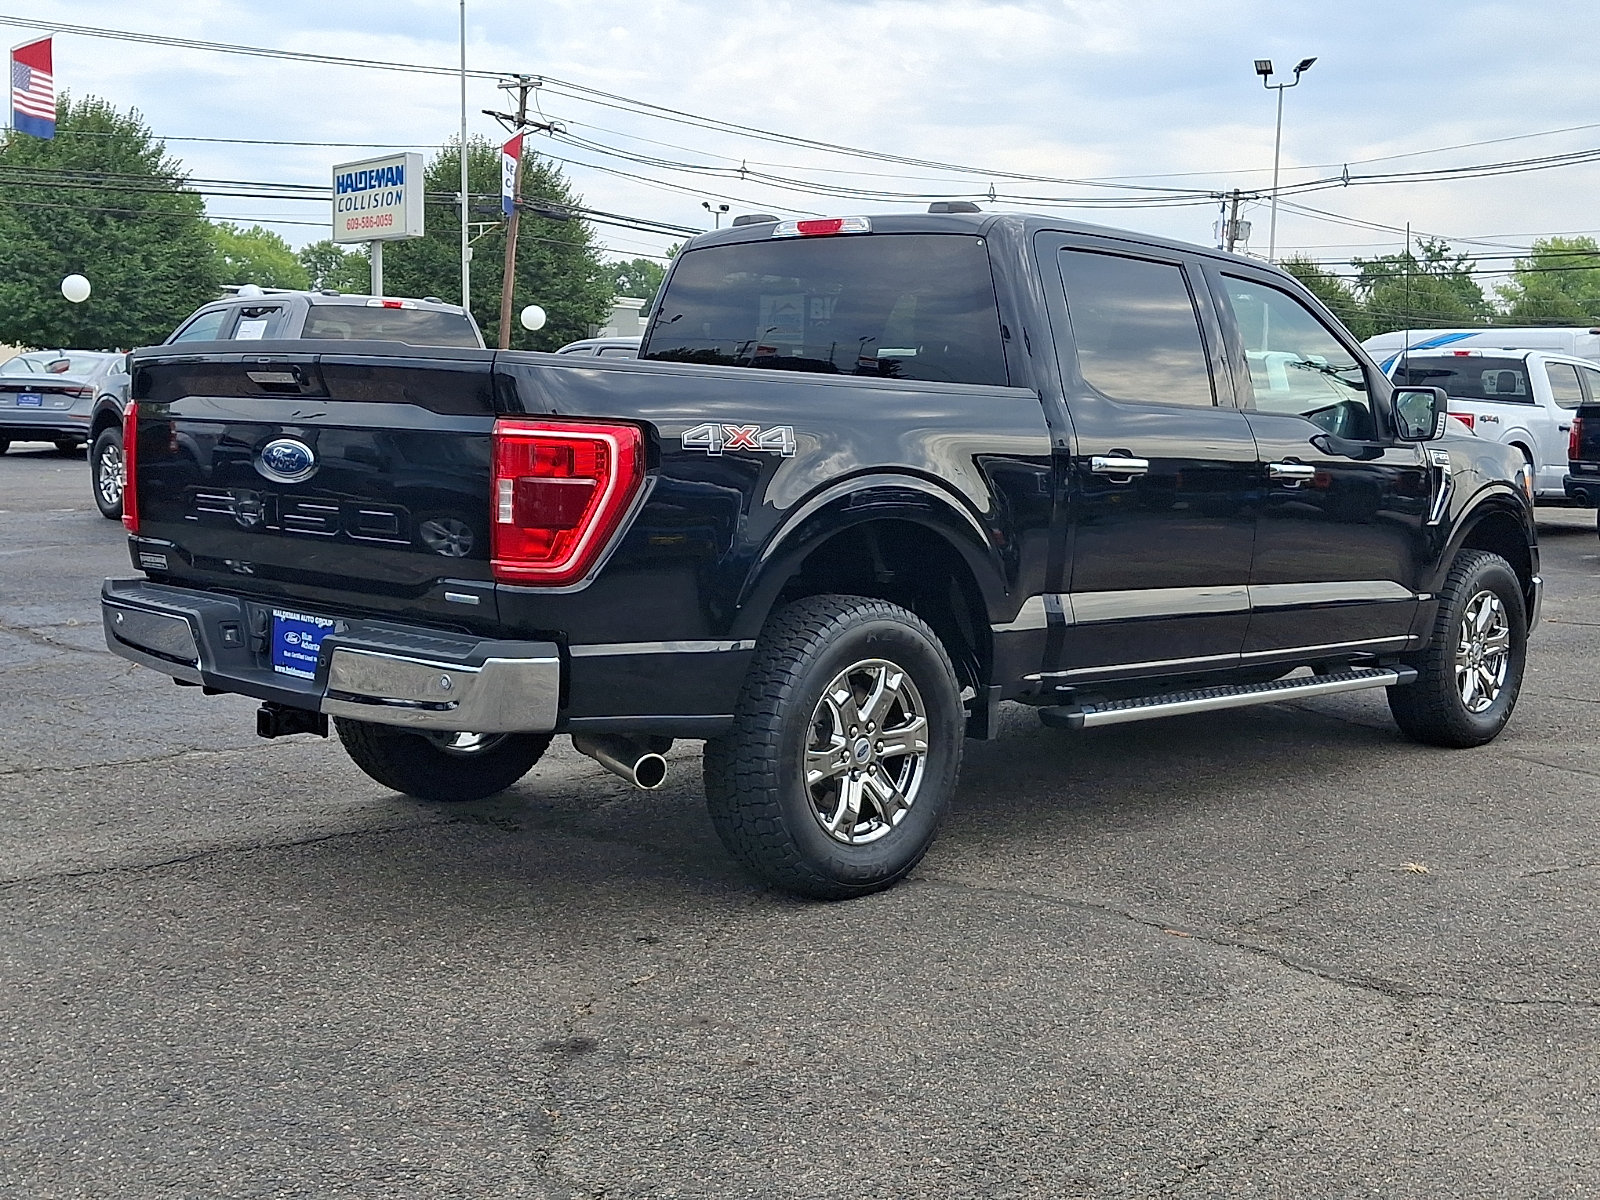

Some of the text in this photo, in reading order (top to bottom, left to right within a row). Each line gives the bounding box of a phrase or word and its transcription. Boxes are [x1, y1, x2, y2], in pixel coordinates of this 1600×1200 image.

[336, 164, 404, 195] HALDEMAN
[338, 189, 403, 212] COLLISION
[346, 213, 393, 230] 609-586-0059
[301, 614, 314, 623] AUTO
[315, 617, 333, 627] GROUP
